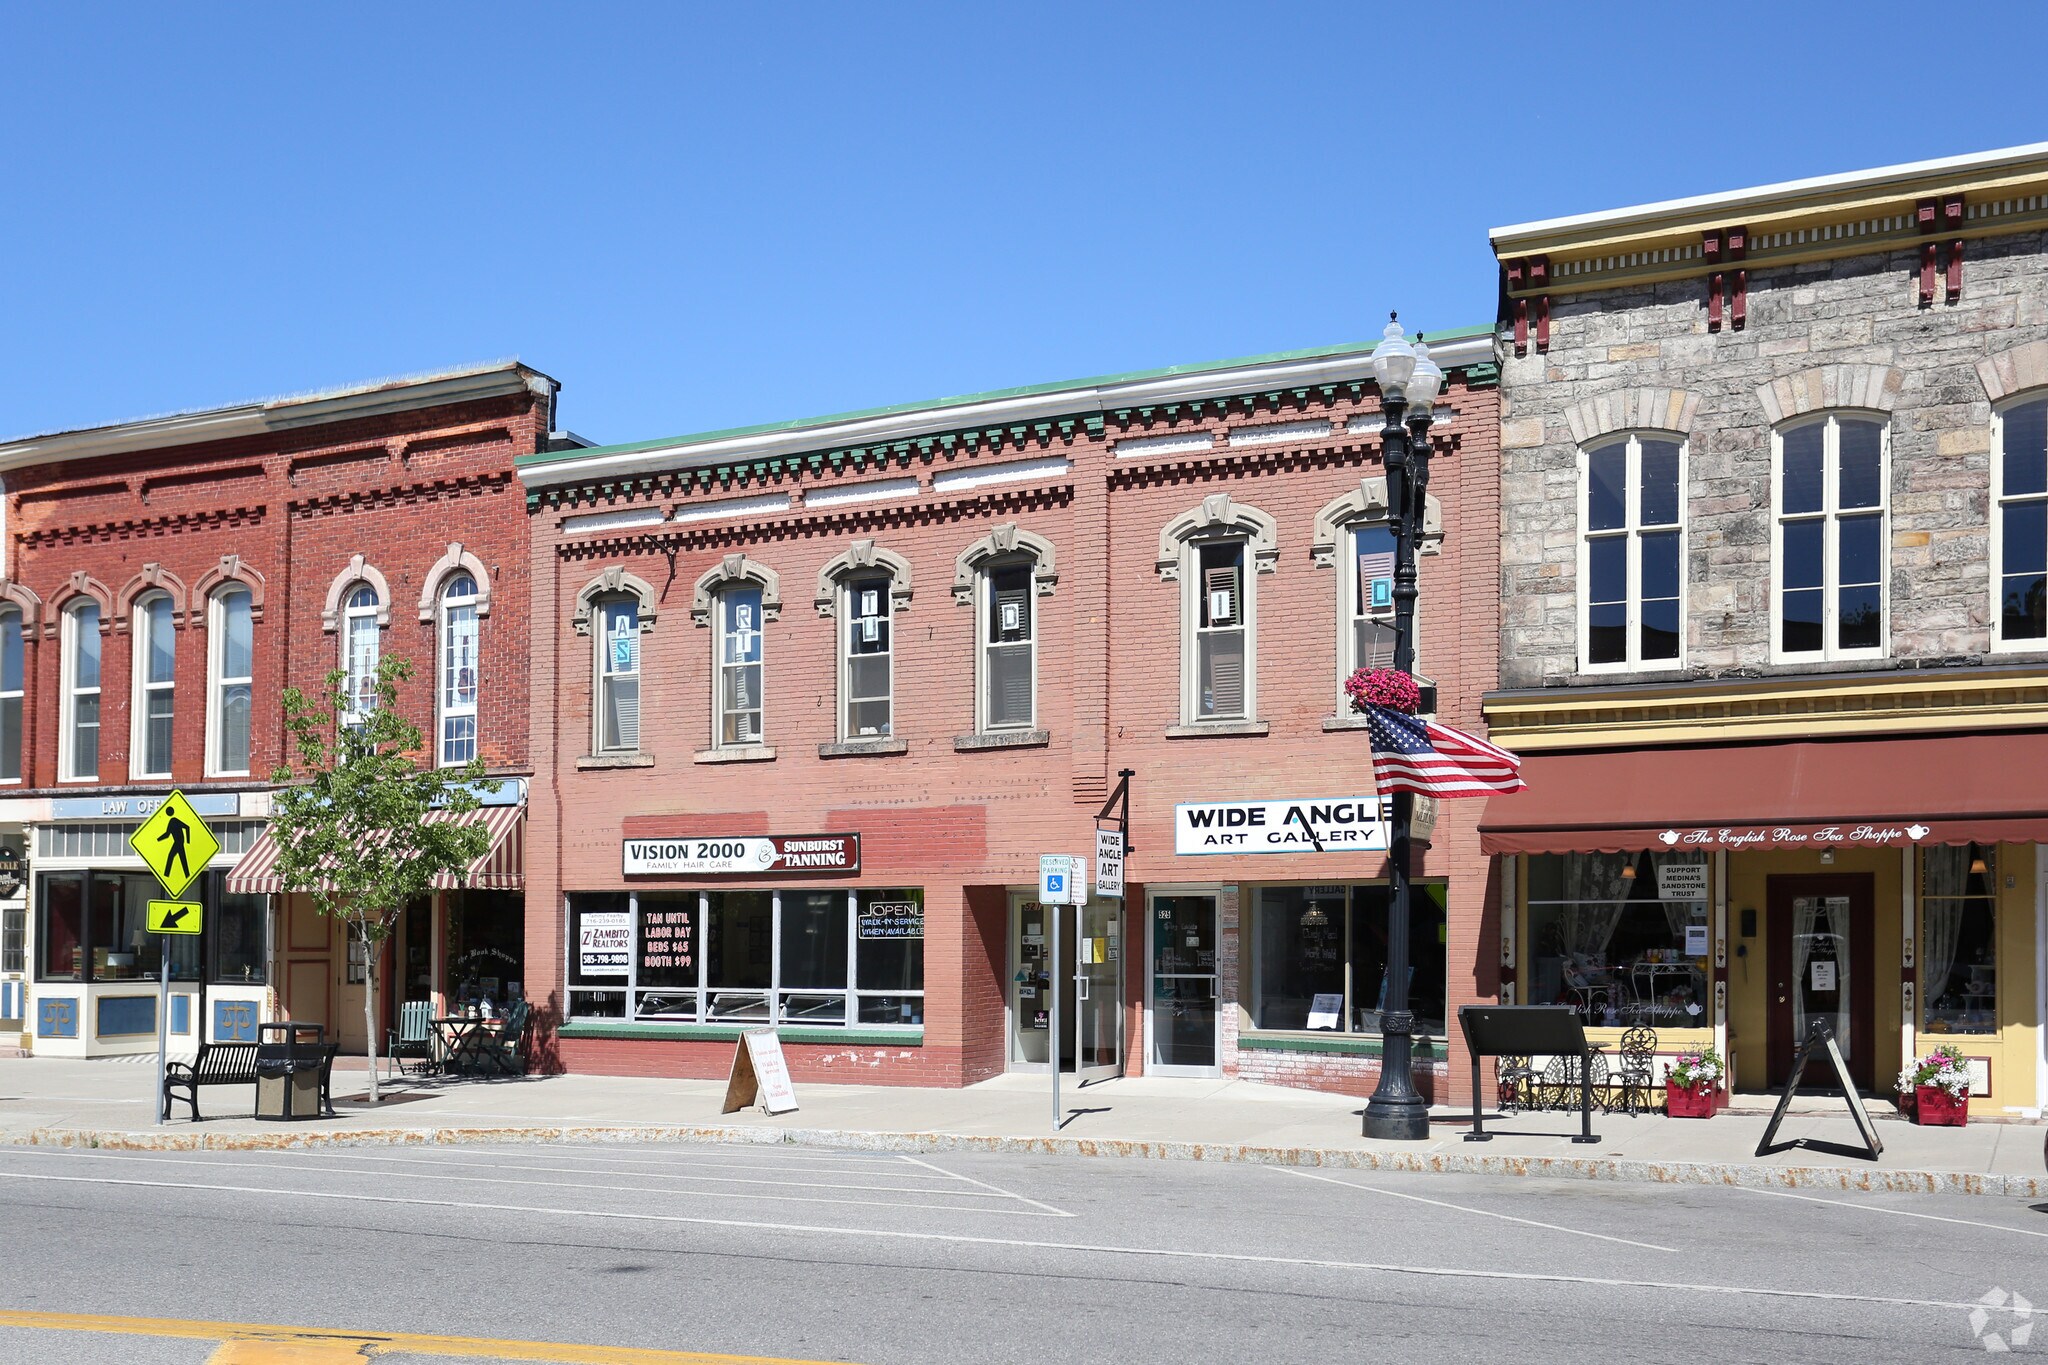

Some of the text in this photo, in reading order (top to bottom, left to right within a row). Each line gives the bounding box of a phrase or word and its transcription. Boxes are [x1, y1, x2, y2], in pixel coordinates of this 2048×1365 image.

[737, 606, 751, 628] R
[737, 630, 751, 651] T
[616, 641, 629, 661] S
[102, 800, 127, 814] LAW
[1187, 803, 1393, 828] WIDE ANGLE
[1101, 835, 1120, 846] WIDE
[1204, 829, 1375, 845] ART GALLERY
[1683, 825, 1902, 847] The English Rose Tea Shoppe
[630, 842, 773, 863] VISION 2000 &
[783, 840, 844, 853] SUNBURST
[783, 851, 846, 867] TANNING
[1099, 848, 1121, 860] ANGLE
[646, 860, 733, 869] FAMILY HAIR CARE
[1042, 858, 1069, 866] RESERVED
[1101, 862, 1118, 876] ART
[1098, 880, 1121, 891] GALLERY
[872, 904, 914, 916] OPEN
[646, 912, 690, 924] TAN UNTIL
[593, 929, 630, 939] ZAMBITO
[645, 926, 692, 938] LABOR DAY
[592, 939, 628, 948] REALTORS
[647, 940, 689, 953] BEDS $65
[470, 948, 488, 959] Book
[583, 954, 628, 964] 585-798-9898
[644, 955, 692, 968] BOOTH $99
[1594, 1002, 1619, 1014] Rose
